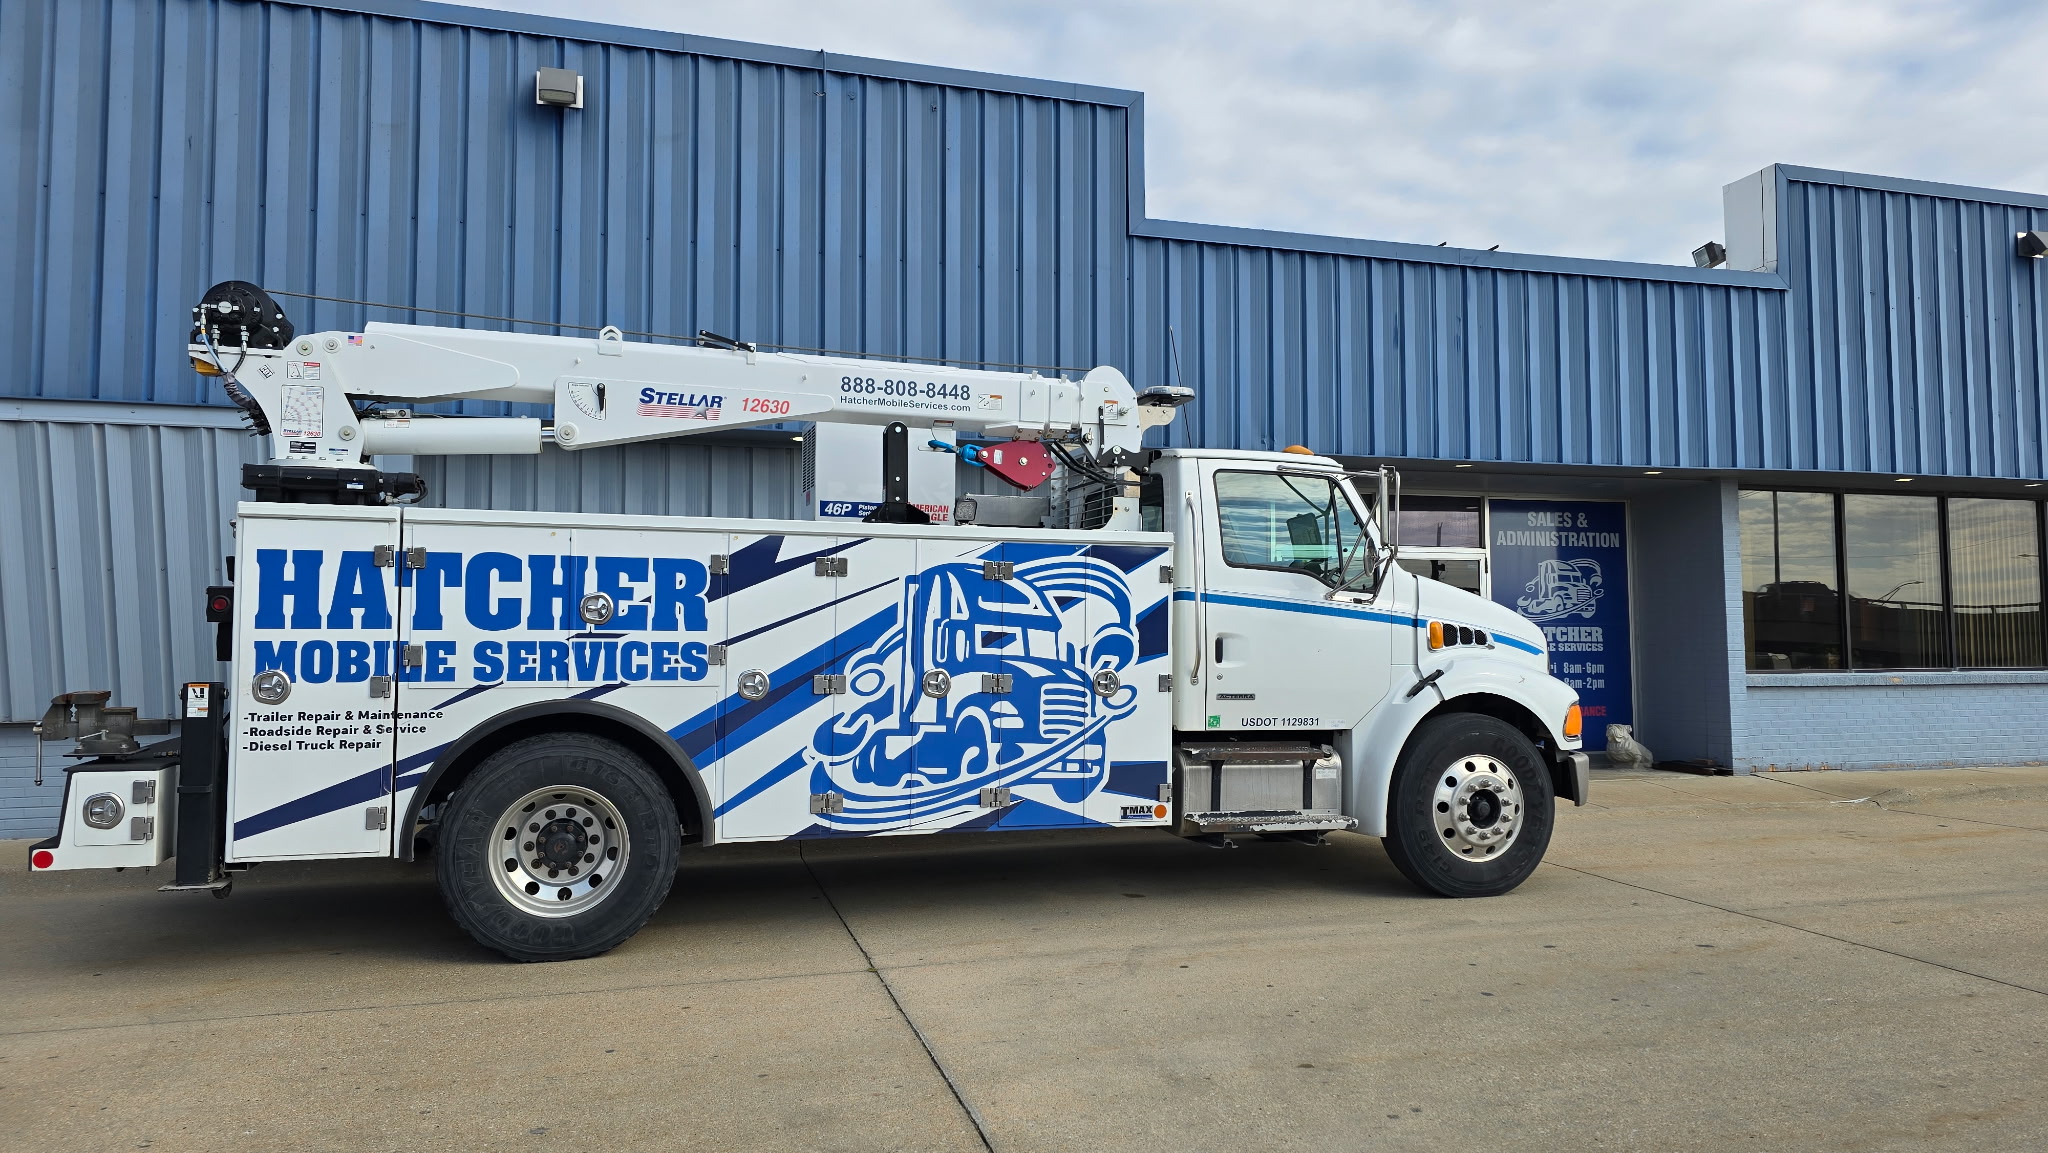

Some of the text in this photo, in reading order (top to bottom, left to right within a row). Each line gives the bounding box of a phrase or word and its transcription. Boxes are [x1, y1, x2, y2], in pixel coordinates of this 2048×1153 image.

[840, 376, 971, 401] 888-808-8448
[639, 387, 790, 415] STELLAR 12630
[840, 395, 971, 412] HatcherMobileServices.com
[824, 502, 852, 516] 46P
[931, 513, 949, 521] GLE
[1527, 511, 1588, 528] SALES &
[1496, 531, 1620, 548] ADMINISTRATION
[255, 548, 708, 632] HATCHER
[1540, 627, 1603, 642] TCHER
[1558, 643, 1604, 652] SERVICES
[255, 639, 709, 683] MOBILE SERVICES
[1563, 662, 1605, 675] 8am-6pm
[244, 710, 444, 724] -Trailer Repair & Maintenance
[1241, 717, 1278, 727] USDOT
[1281, 717, 1319, 727] 1129831
[243, 726, 312, 737] -Roadside
[316, 725, 359, 738] Repair
[363, 725, 372, 735] &
[243, 739, 382, 752] -Diesel Truck Repair
[1121, 805, 1152, 819] TMAX
